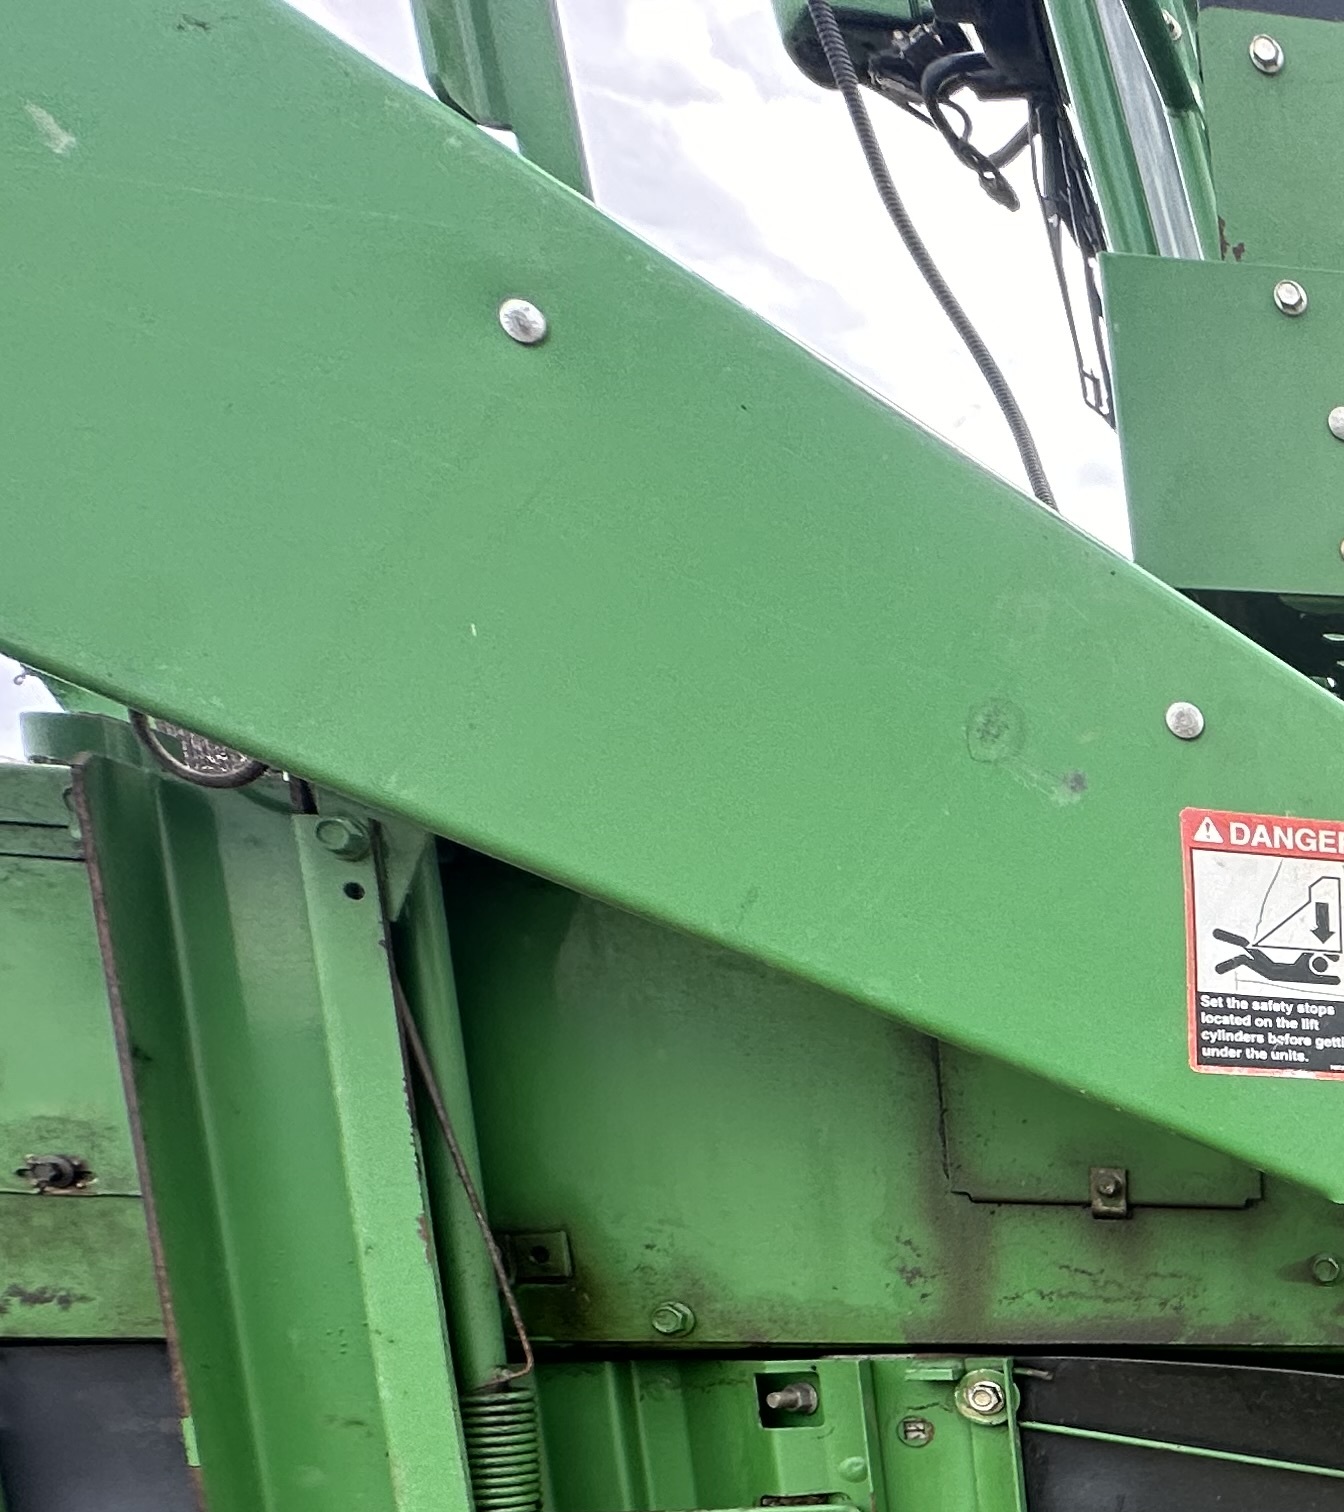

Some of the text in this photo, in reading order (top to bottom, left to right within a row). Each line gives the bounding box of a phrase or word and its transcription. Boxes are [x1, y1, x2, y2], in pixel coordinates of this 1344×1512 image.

[1200, 995, 1336, 1016] Set the safety stops
[1200, 1012, 1320, 1030] located on the lift
[1201, 1029, 1265, 1044] cylinders
[1268, 1032, 1312, 1047] before
[1202, 1046, 1309, 1063] under the units.
